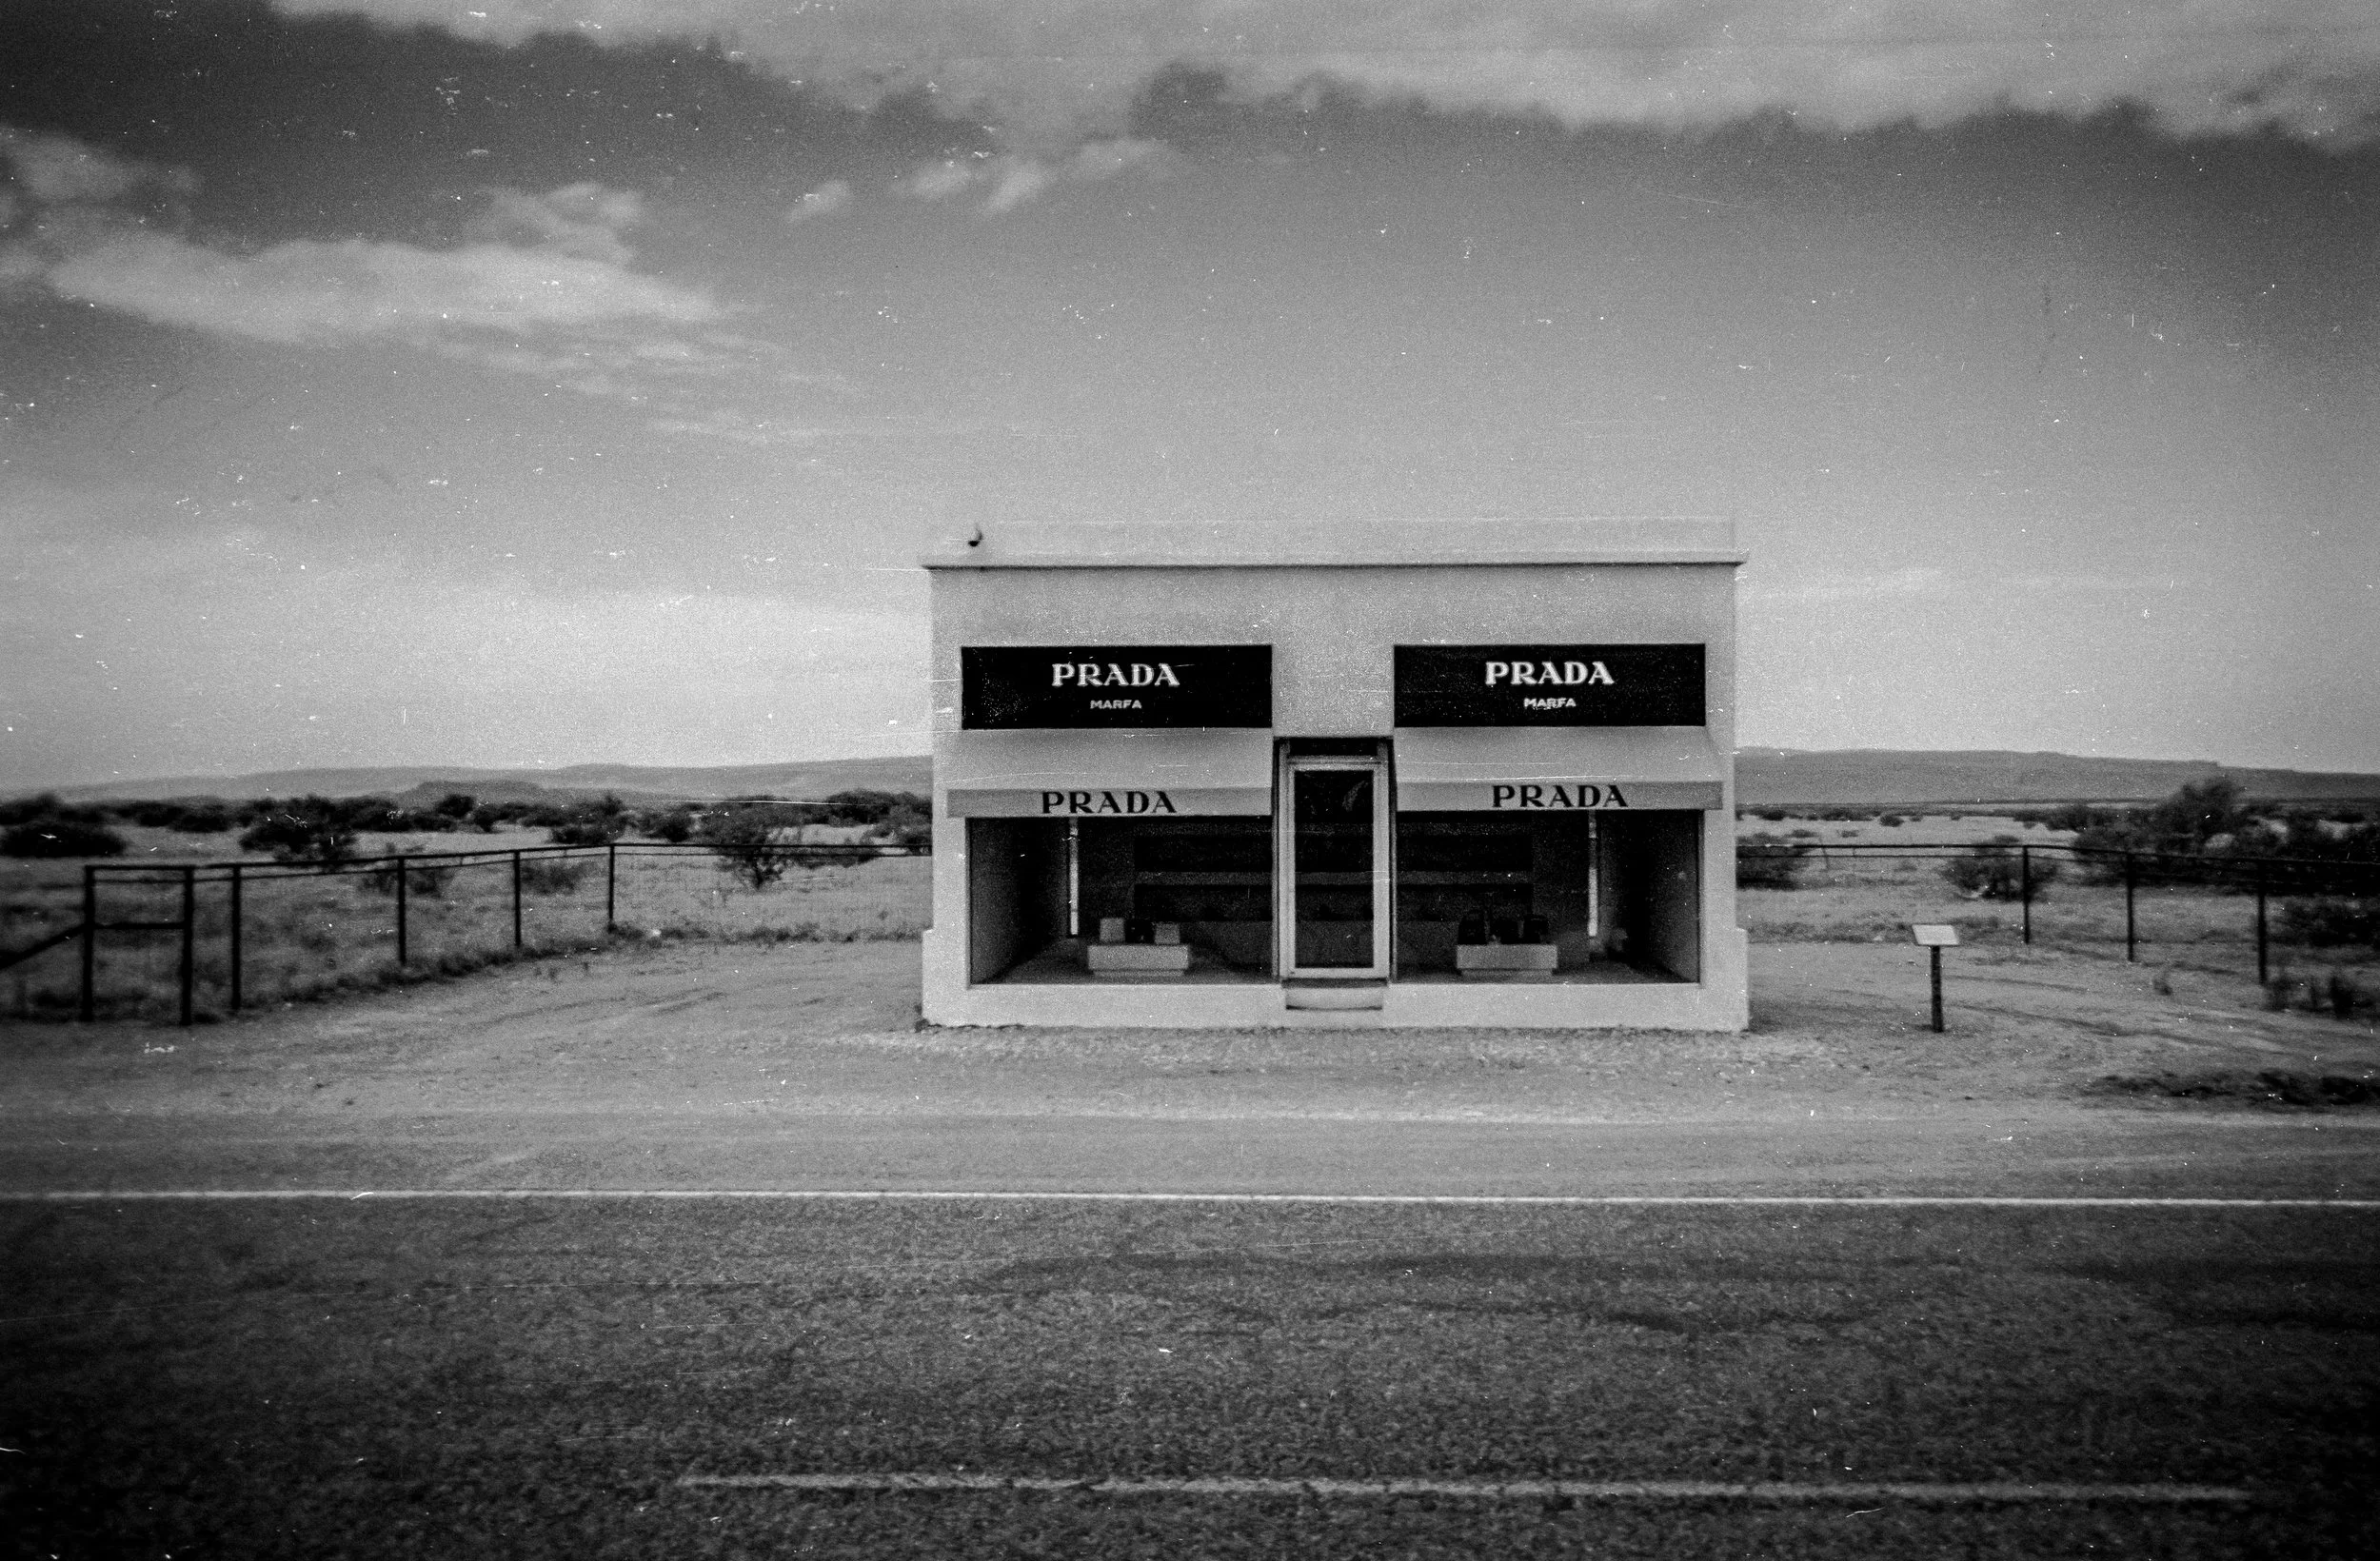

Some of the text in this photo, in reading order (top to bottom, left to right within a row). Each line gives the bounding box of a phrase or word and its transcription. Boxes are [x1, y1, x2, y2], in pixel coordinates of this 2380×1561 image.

[1051, 662, 1180, 687] PRADA
[1484, 661, 1615, 685] PRADA
[1090, 700, 1142, 710] MARFA
[1523, 698, 1577, 708] MARFA
[1041, 790, 1178, 815] PRADA
[1492, 783, 1629, 808] PRADA
